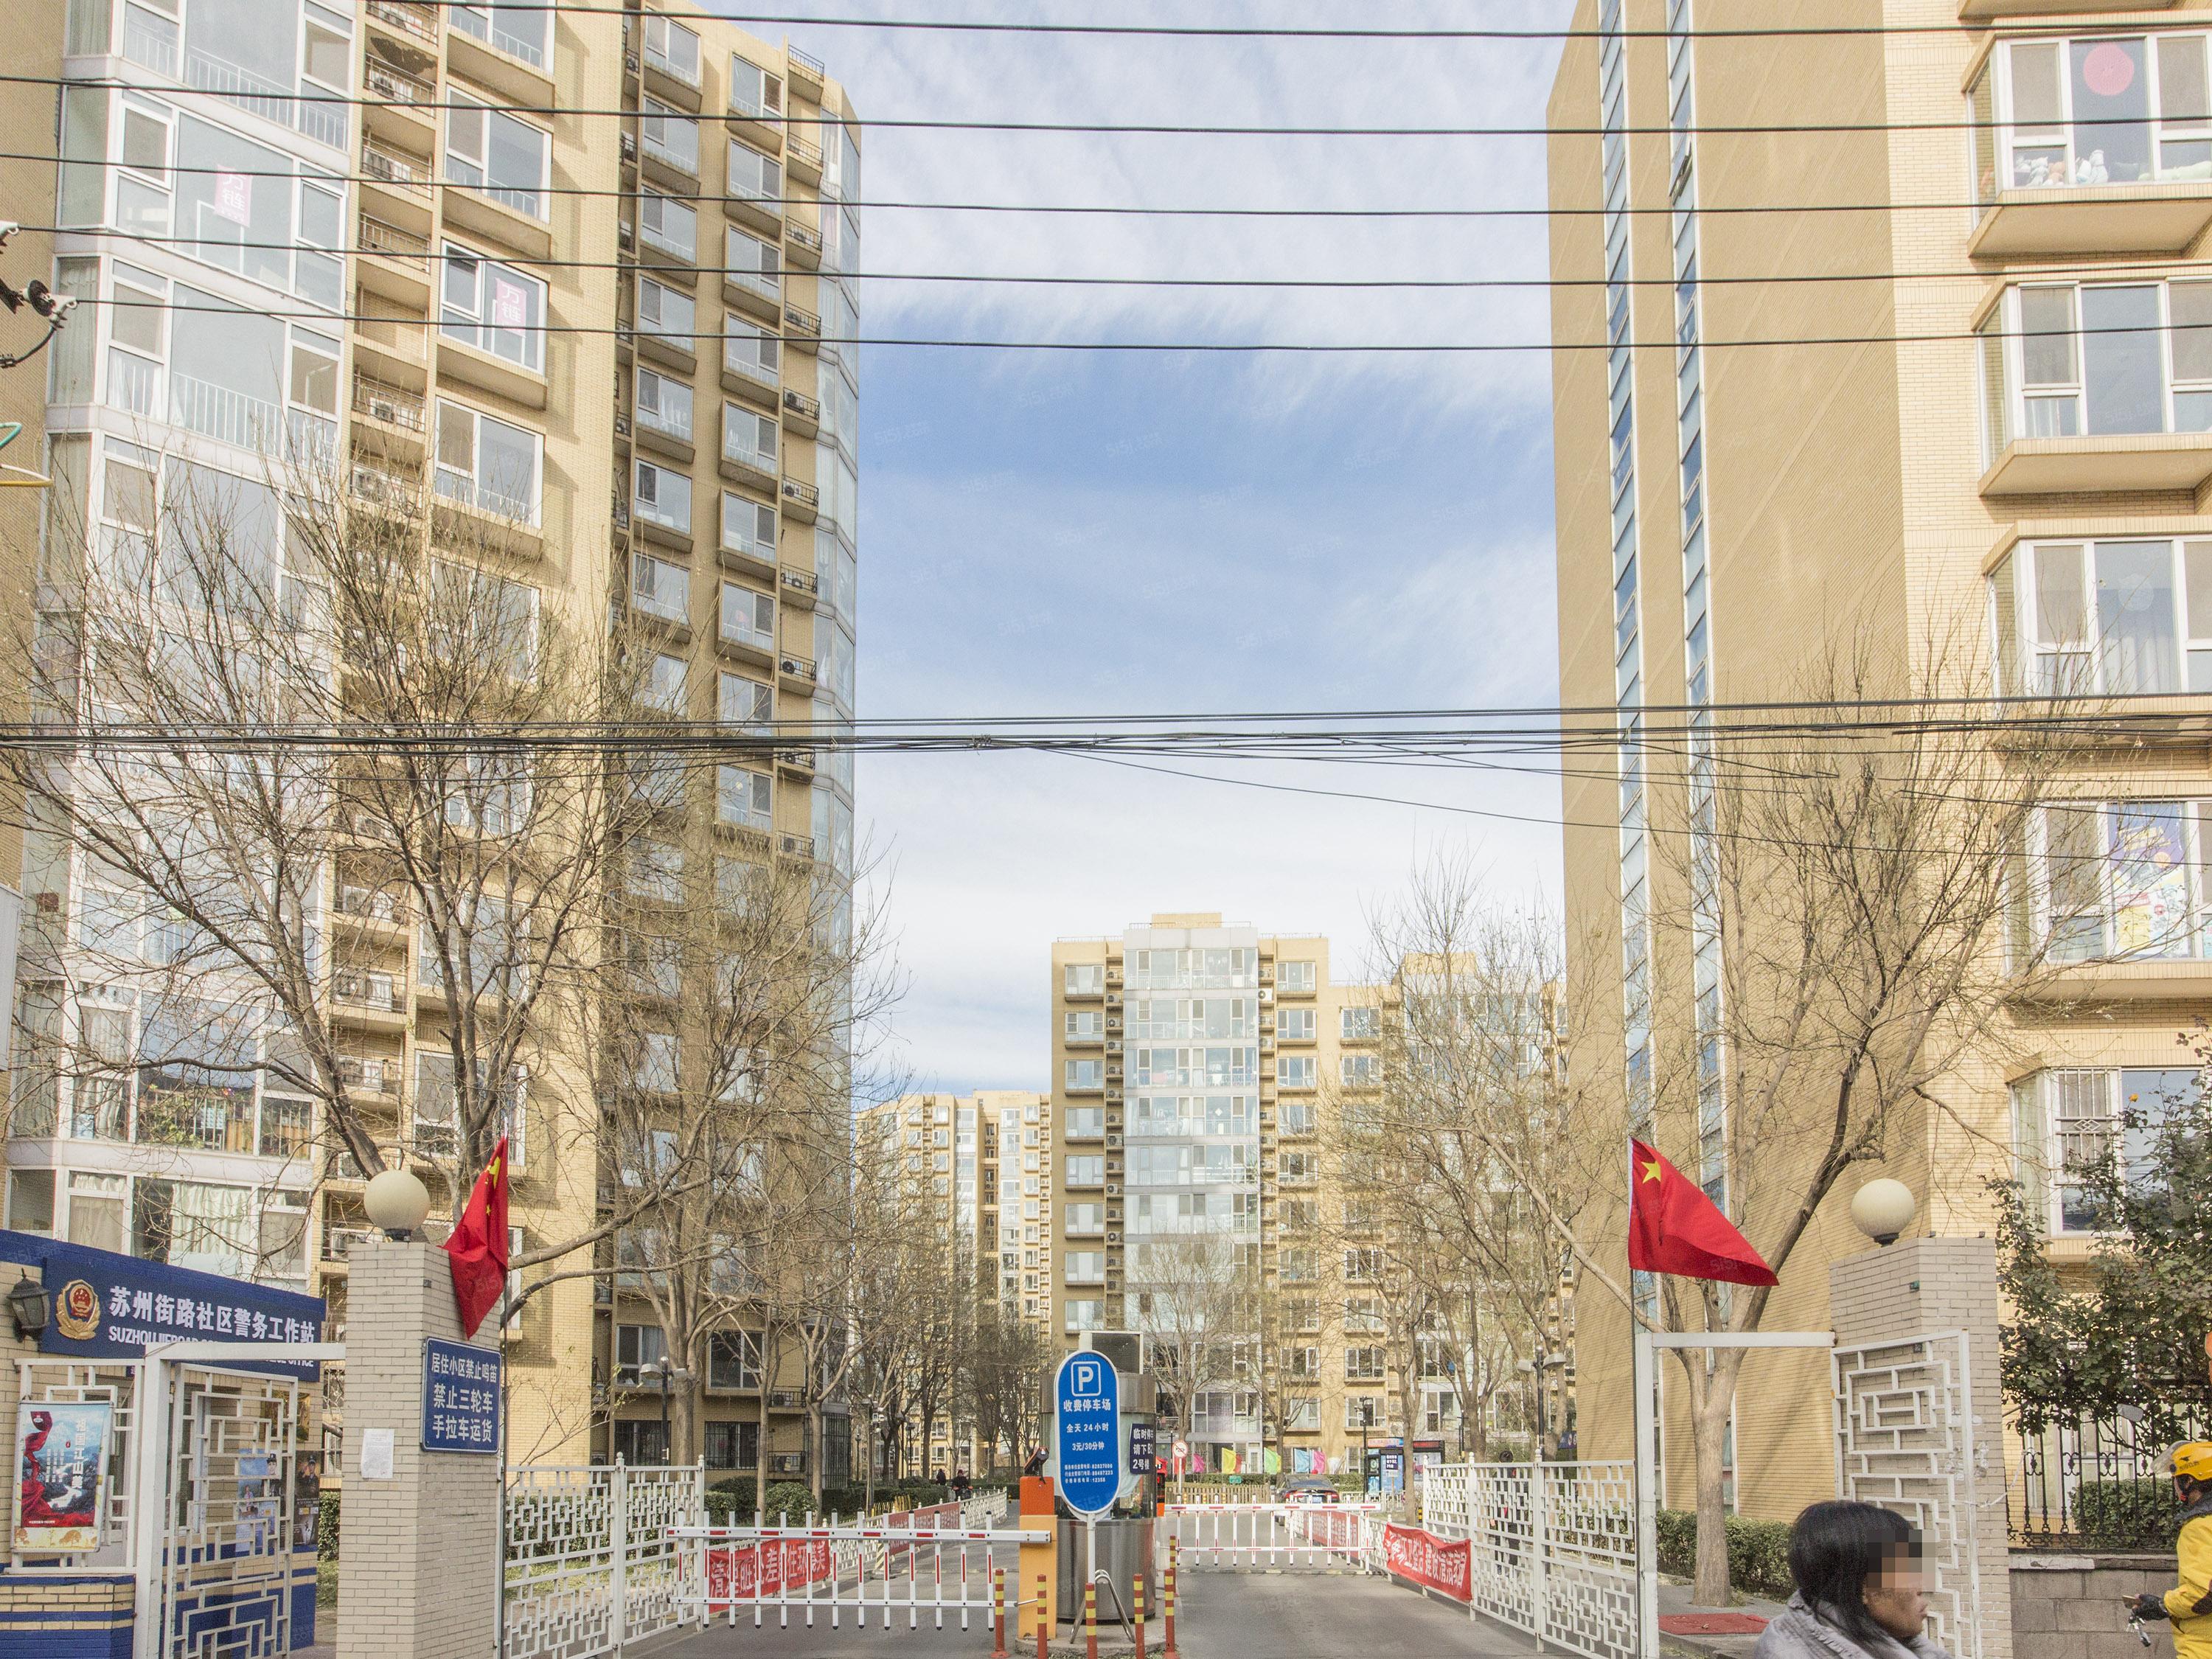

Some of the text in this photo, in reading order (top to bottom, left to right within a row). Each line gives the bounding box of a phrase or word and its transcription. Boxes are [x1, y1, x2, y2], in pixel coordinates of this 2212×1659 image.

[108, 1285, 315, 1344] 苏州街路社区警务工作站
[431, 1352, 498, 1383] 居住小区禁止鸣笛
[1078, 1366, 1093, 1392] P
[434, 1382, 493, 1414] 禁止三轮车
[1063, 1398, 1111, 1412] 收费停车场
[432, 1414, 493, 1443] 手拉车运货
[1072, 1441, 1105, 1451] 3元/30分钟
[1133, 1458, 1150, 1470] 2号楼
